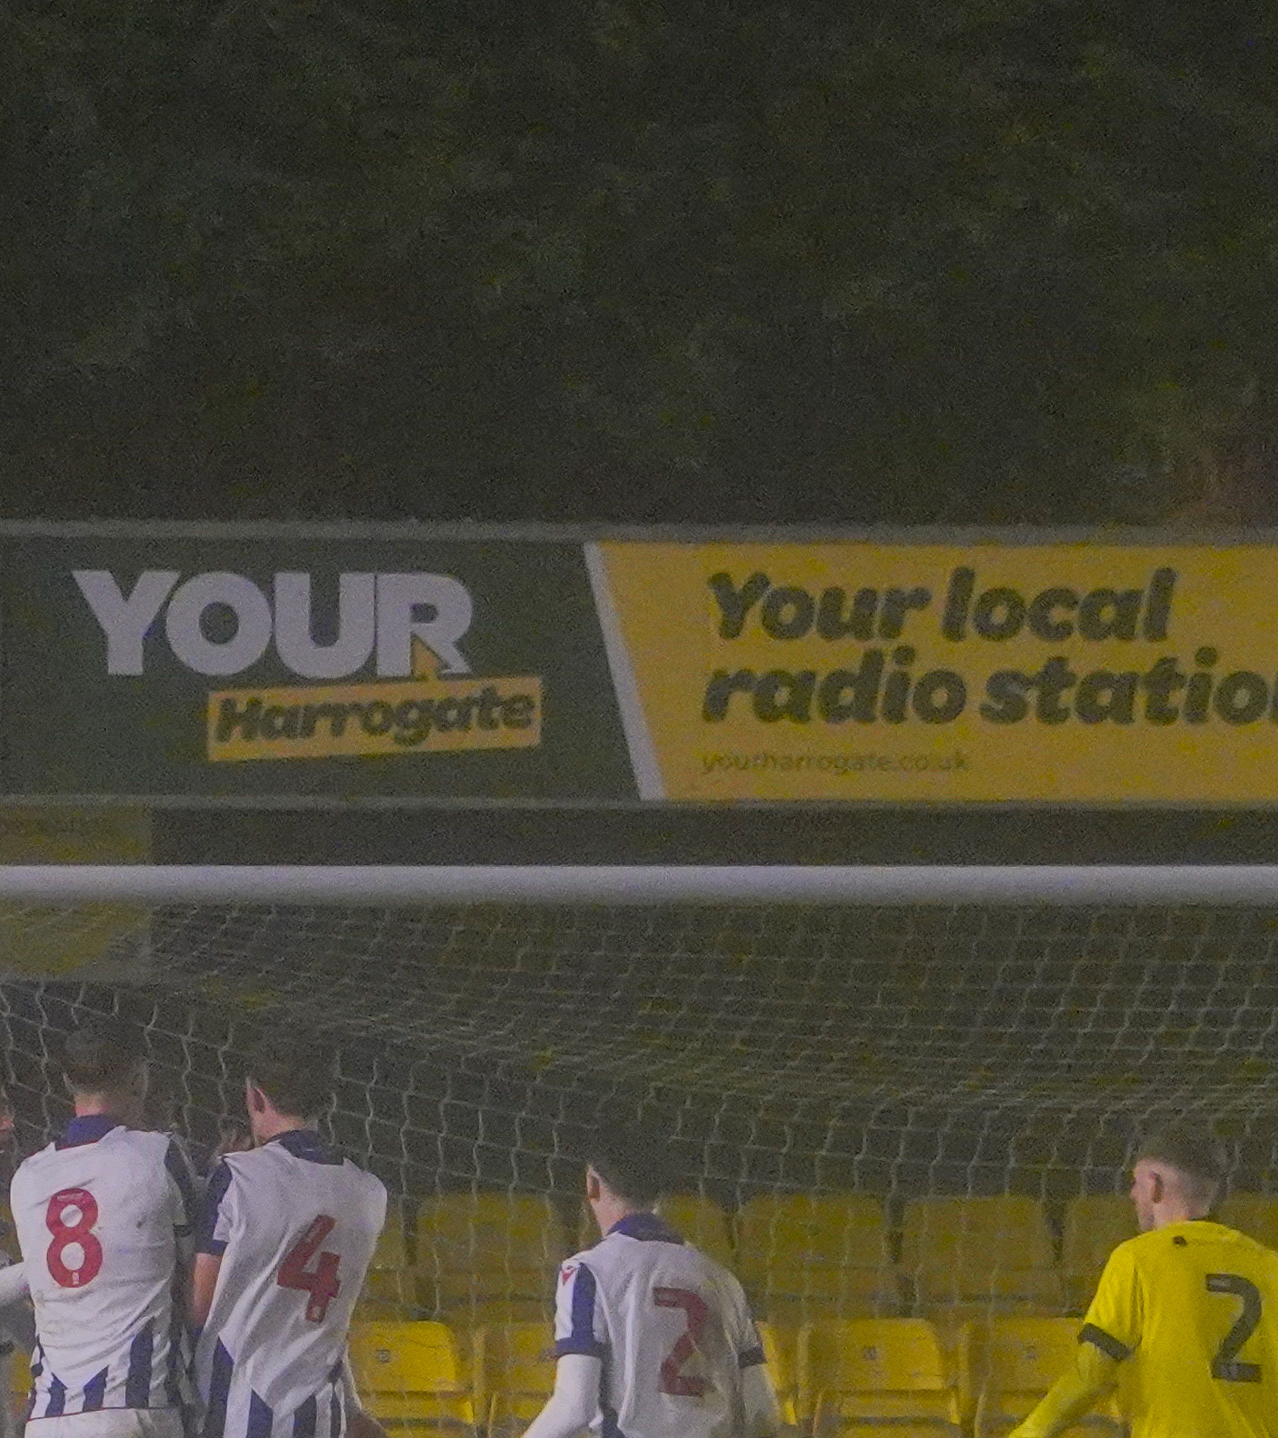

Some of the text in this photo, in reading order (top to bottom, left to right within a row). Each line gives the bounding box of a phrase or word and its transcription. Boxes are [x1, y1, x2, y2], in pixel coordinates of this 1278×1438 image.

[72, 570, 474, 679] YOUR
[706, 566, 1178, 643] Your local
[217, 686, 534, 746] Harrogate
[702, 645, 968, 726] radio
[46, 1187, 104, 1289] 8
[276, 1213, 341, 1324] 4
[652, 1286, 708, 1398] 2
[1204, 1272, 1264, 1383] 2
